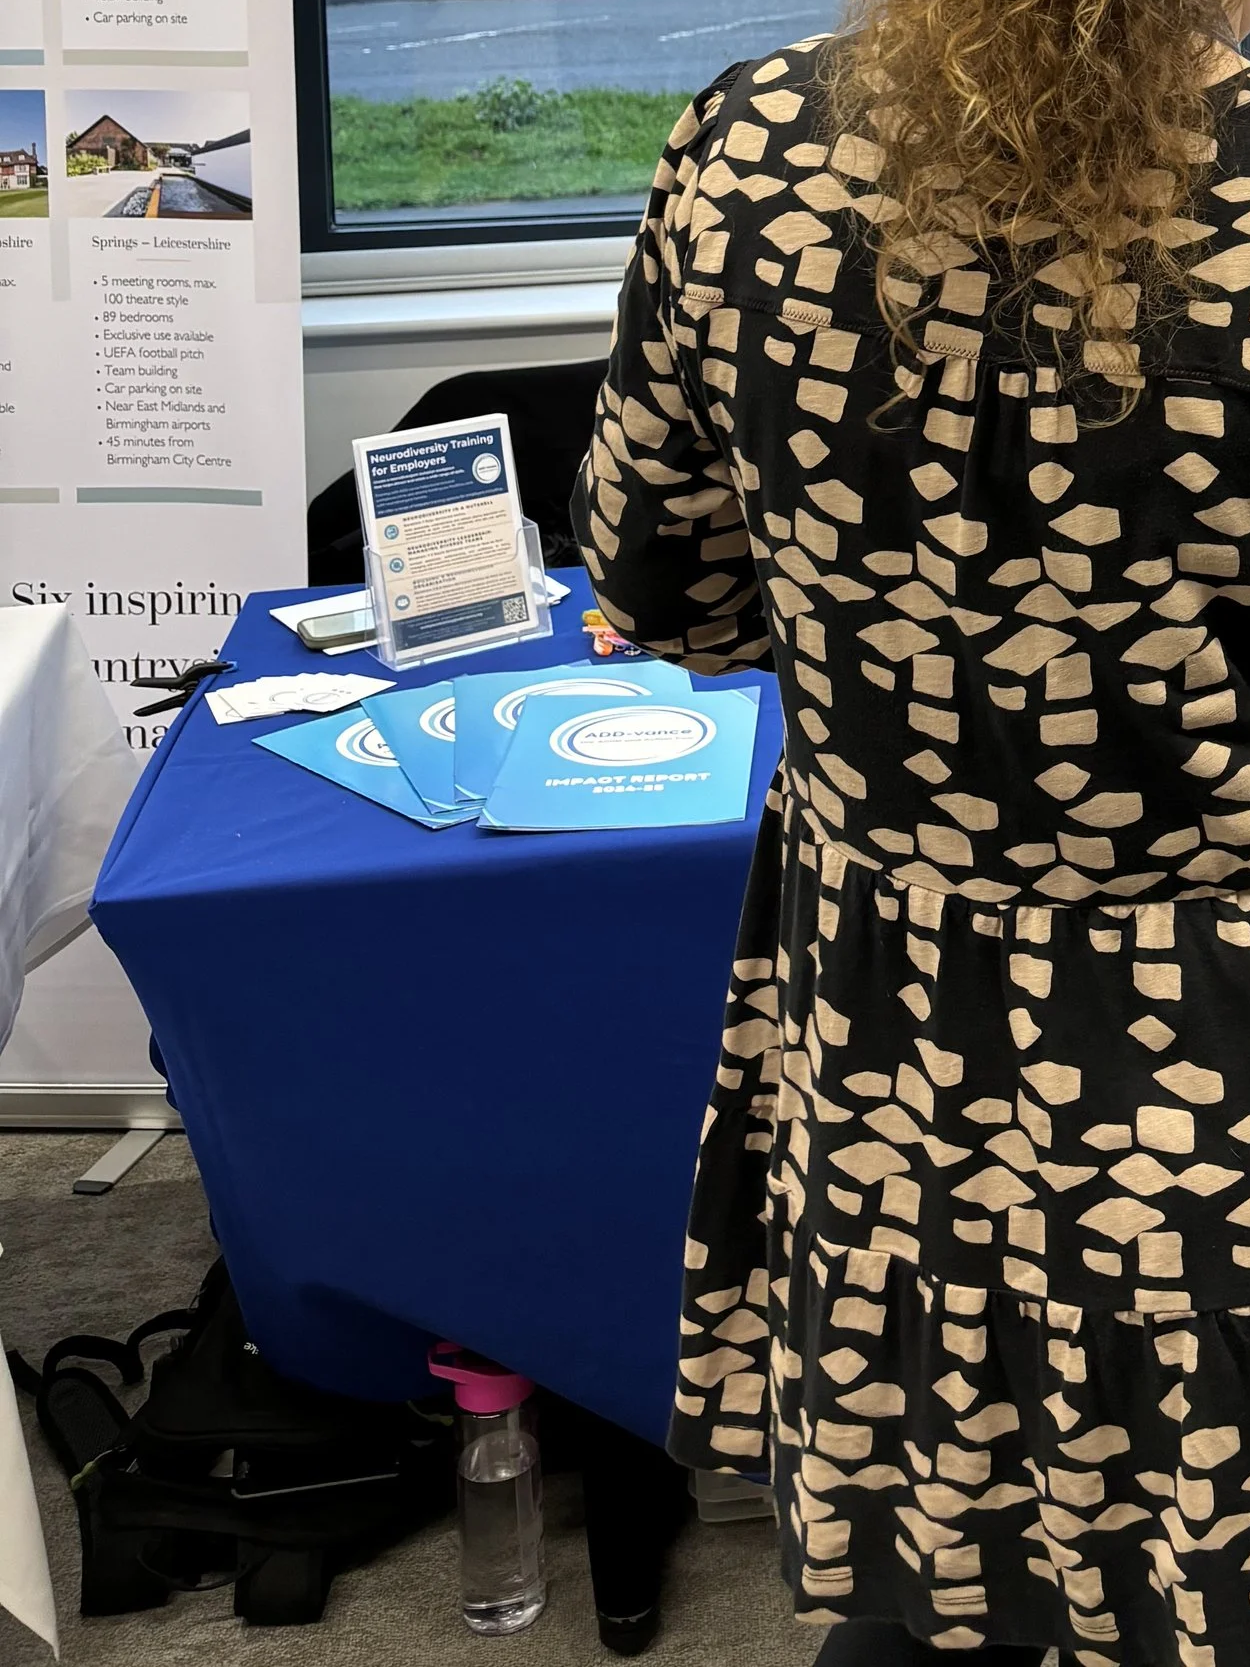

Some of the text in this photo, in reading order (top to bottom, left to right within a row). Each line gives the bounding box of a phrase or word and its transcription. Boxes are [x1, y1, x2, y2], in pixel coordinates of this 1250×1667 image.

[93, 12, 188, 26] Car parking on site
[92, 235, 138, 251] Springs
[153, 236, 231, 250] Leicestershire
[101, 276, 108, 286] 5
[111, 276, 154, 290] meeting
[103, 294, 189, 308] 100 theatre style
[103, 312, 174, 323] 89 bedrooms
[103, 330, 214, 342] Exclusive use available
[103, 347, 204, 361] UEFA football pitch
[104, 365, 178, 379] Team building
[105, 383, 202, 397] Car parking on site
[106, 401, 226, 414] Near East Midlands and
[106, 419, 211, 433] Birmingham airports
[106, 436, 194, 447] 45 minutes from
[370, 434, 494, 464] Neurodiversity Training
[107, 454, 232, 468] Birmingham City Centre
[371, 456, 446, 476] for Employers
[85, 582, 242, 626] inspirin
[585, 728, 692, 739] ADD-vance
[545, 772, 711, 787] IMPACT REPORT
